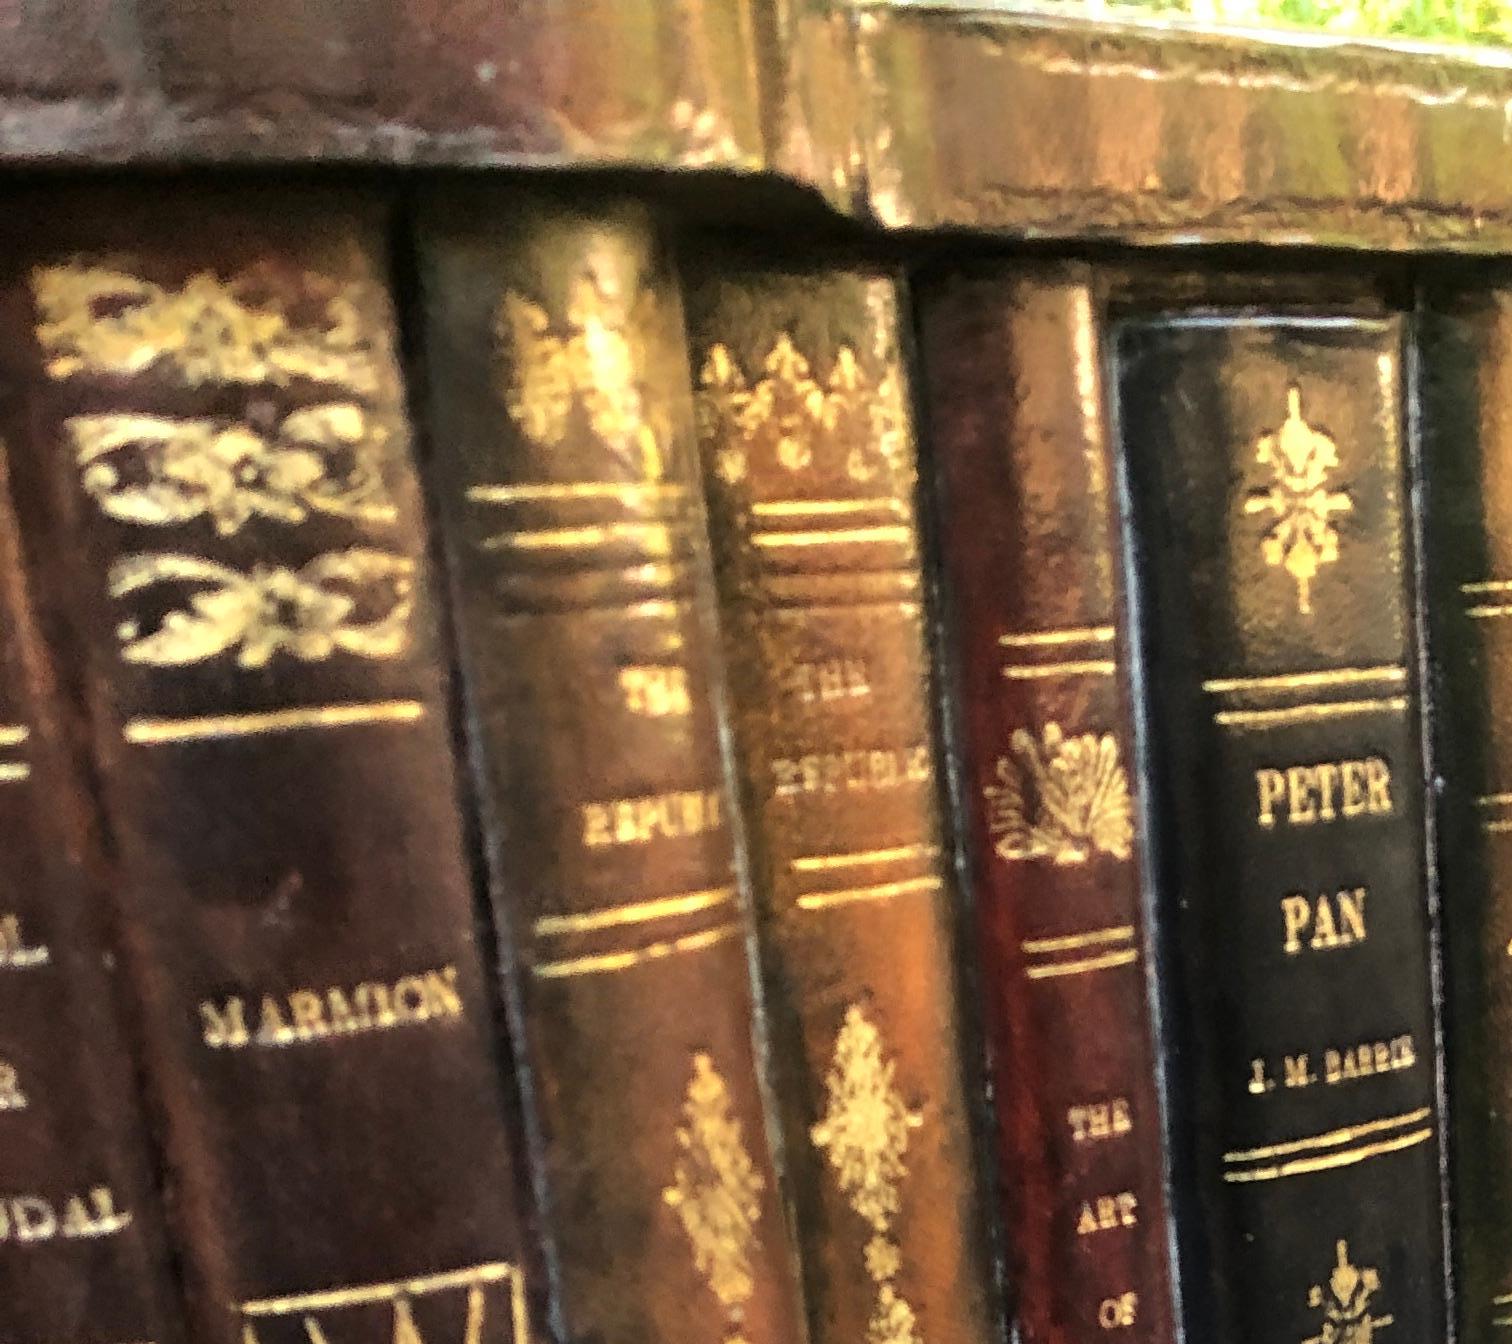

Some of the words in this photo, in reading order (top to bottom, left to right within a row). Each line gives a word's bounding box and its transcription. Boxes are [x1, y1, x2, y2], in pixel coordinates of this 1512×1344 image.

[1255, 756, 1393, 828] PETER
[1281, 887, 1368, 955] PAN
[200, 965, 461, 1048] MARMION
[1068, 1097, 1133, 1141] THE
[0, 1186, 133, 1241] DAL
[1077, 1191, 1138, 1235] ART
[1100, 1291, 1139, 1329] OF
